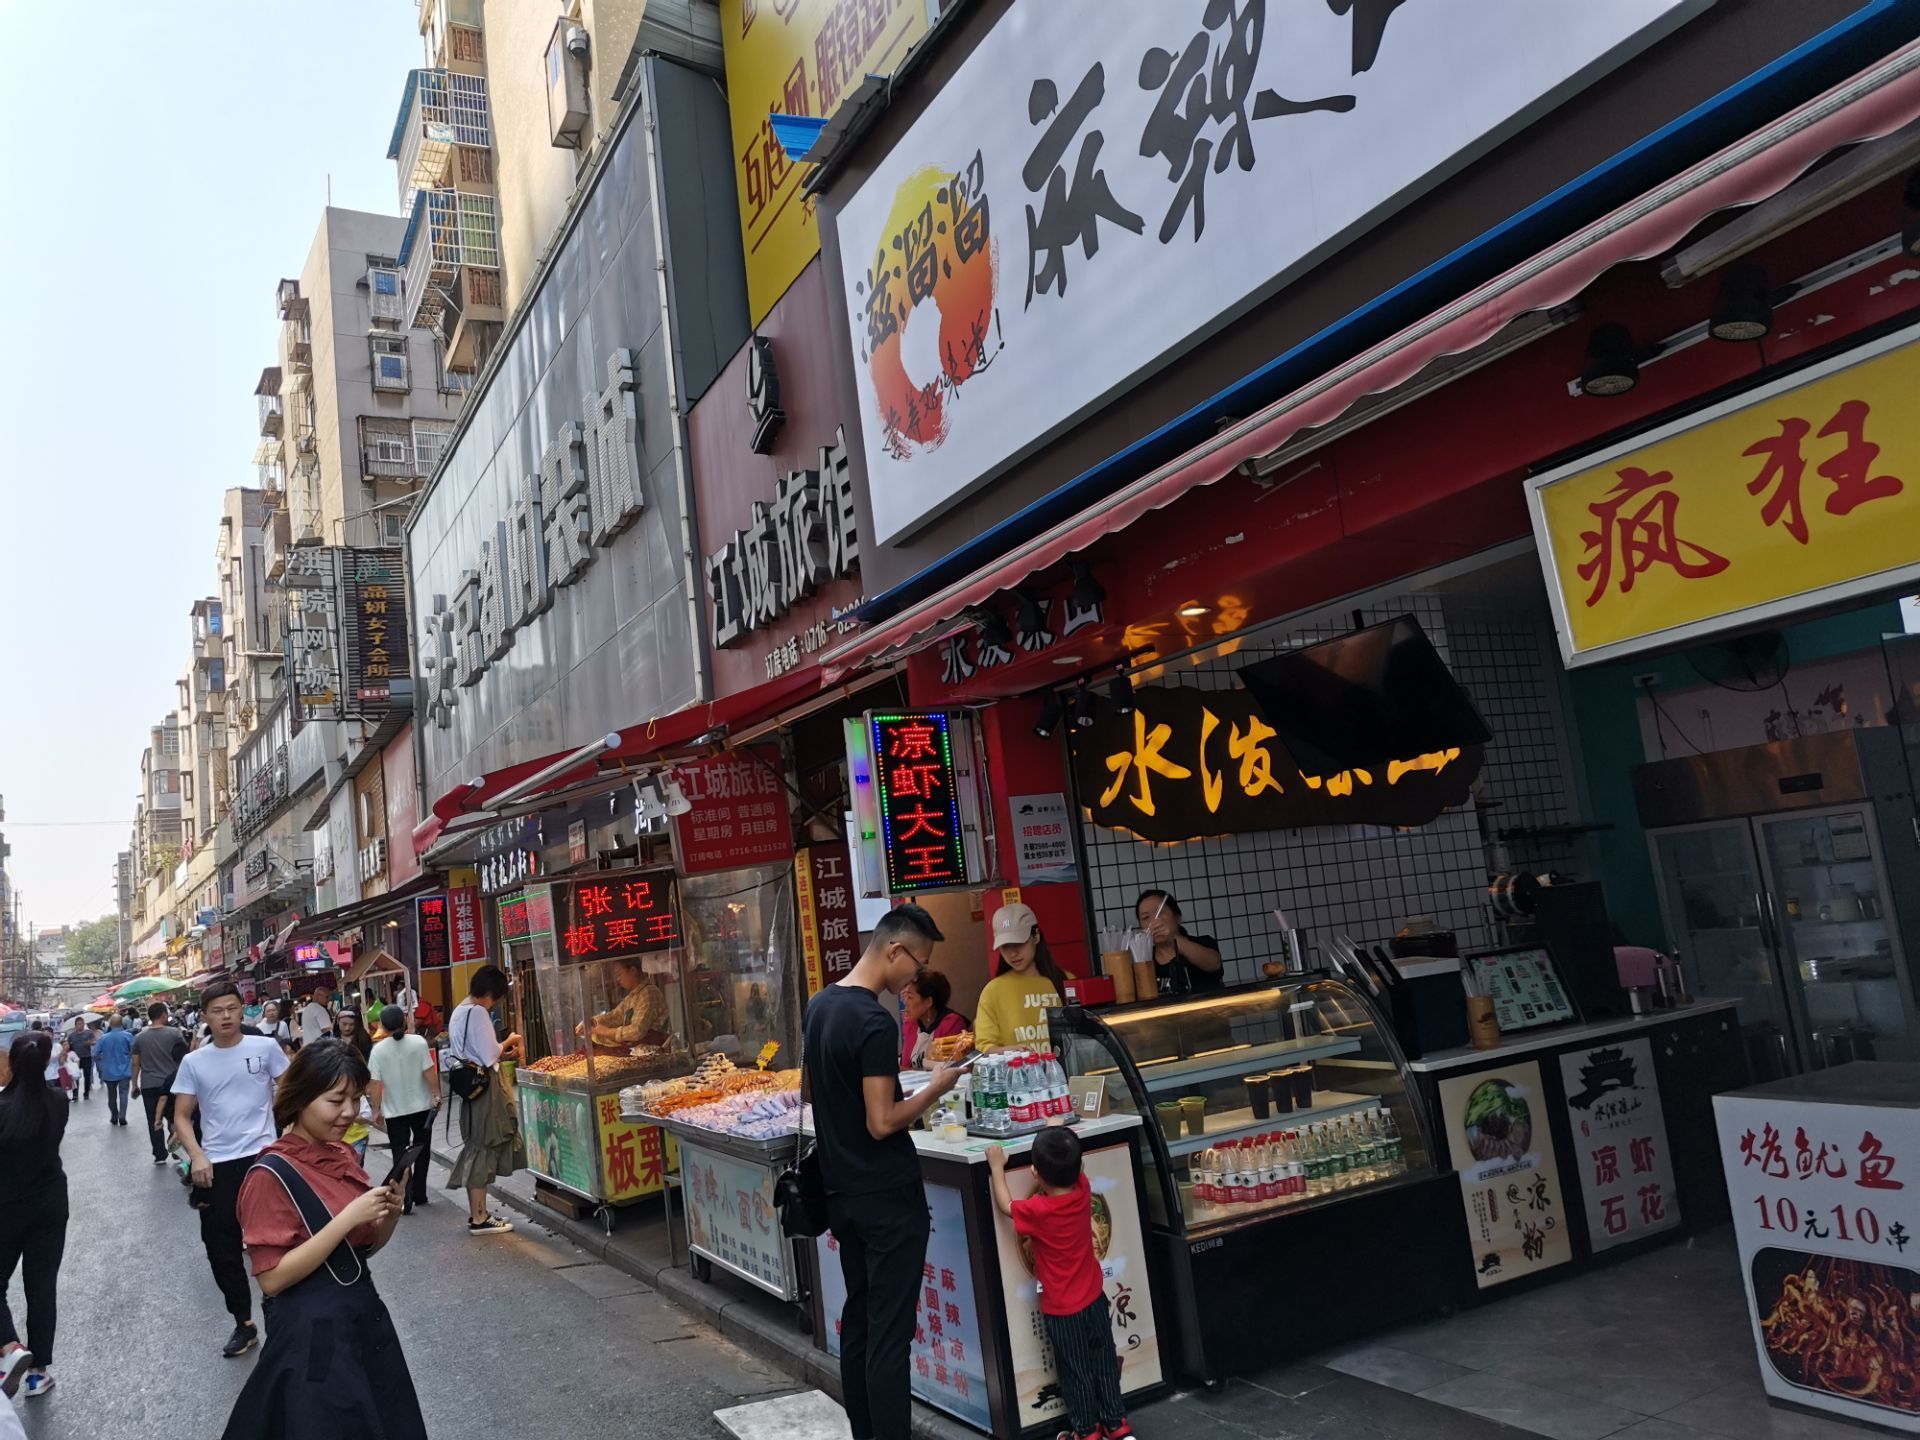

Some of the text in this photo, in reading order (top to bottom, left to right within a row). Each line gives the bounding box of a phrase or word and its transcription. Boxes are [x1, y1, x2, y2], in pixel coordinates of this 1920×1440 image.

[1577, 400, 1904, 608] 疯狂
[706, 424, 860, 650] 江城旅馆
[678, 759, 779, 801] 江城旅馆
[887, 722, 951, 880] 凉虾大王
[691, 802, 776, 824] 标准间 普通间
[693, 819, 778, 842] 星期房 月租房
[579, 881, 653, 917] 张记
[815, 856, 853, 972] 江城旅馆
[564, 914, 678, 957] 板栗王
[1024, 993, 1059, 1008] JUST
[244, 1057, 263, 1075] U
[1591, 1136, 1656, 1187] 凉虾
[1740, 1122, 1905, 1190] 烤鱿鱼
[1600, 1183, 1665, 1235] 石花
[1754, 1194, 1911, 1253] 10元10串
[940, 1267, 970, 1397] 麻辣凉粉
